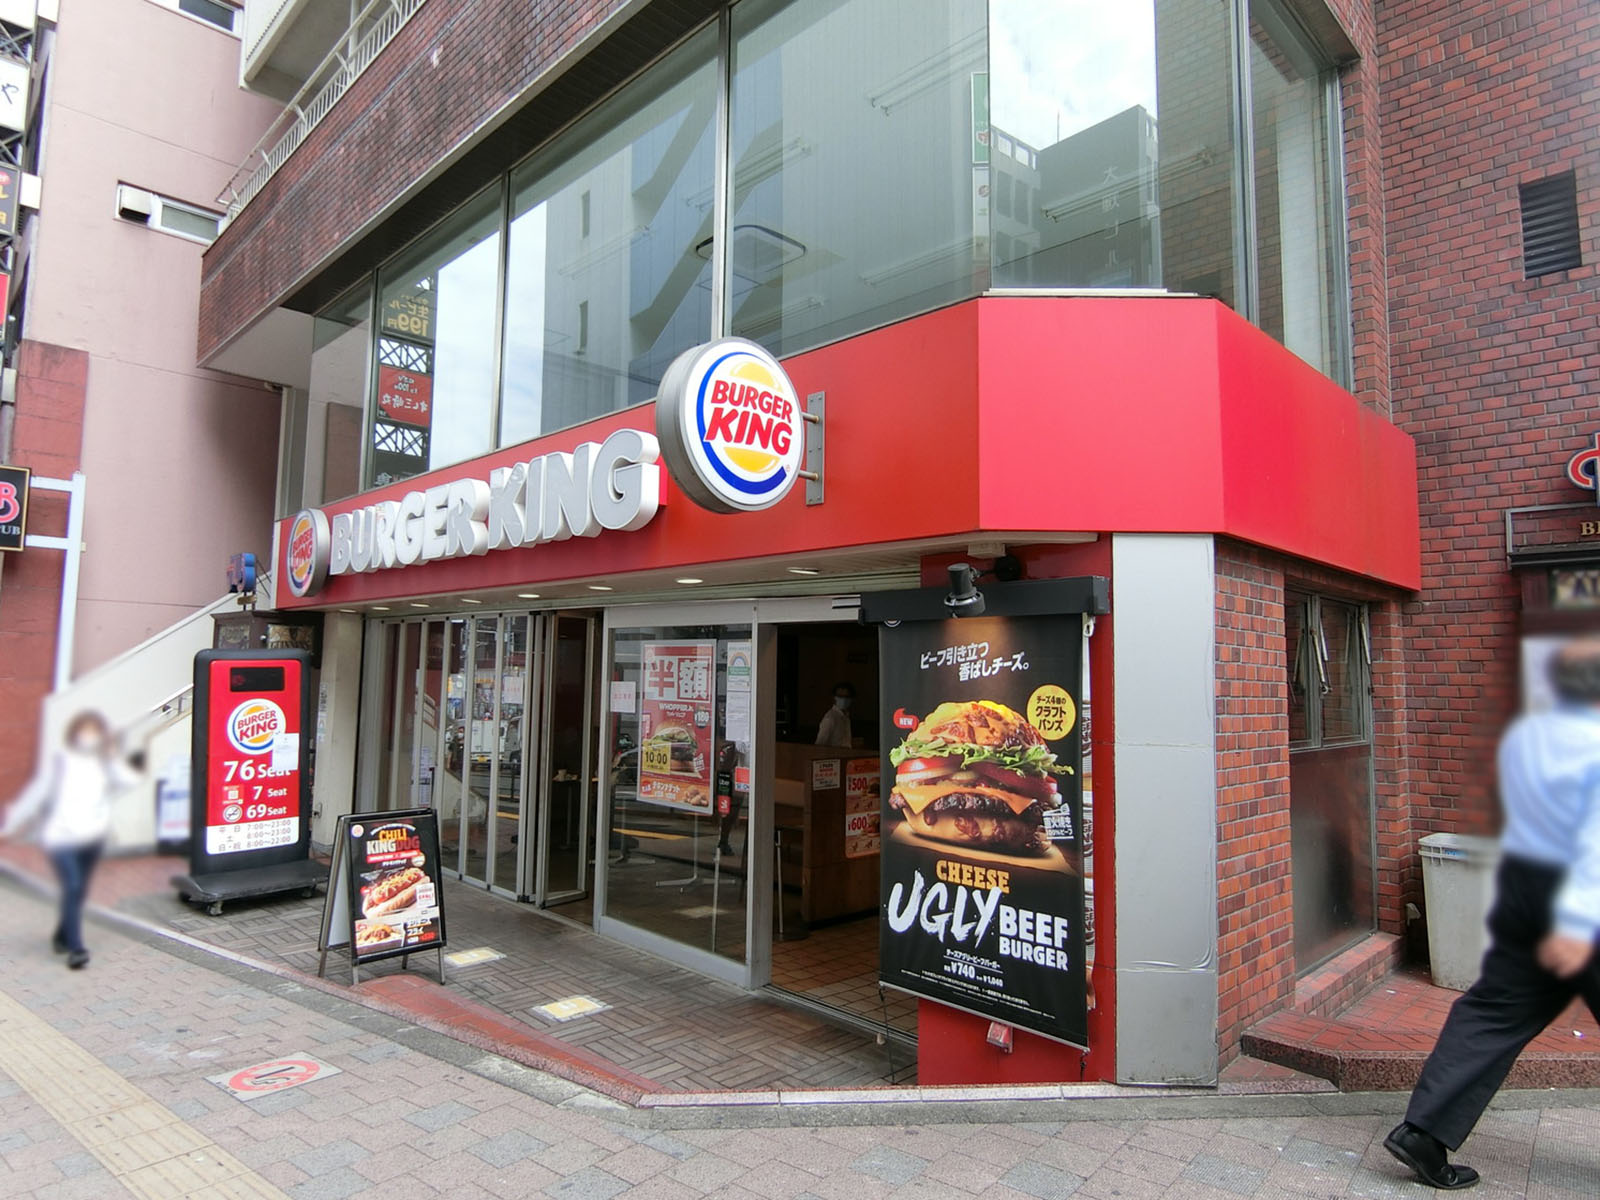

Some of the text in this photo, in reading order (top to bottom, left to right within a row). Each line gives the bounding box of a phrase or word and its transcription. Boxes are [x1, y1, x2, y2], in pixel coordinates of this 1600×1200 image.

[711, 380, 793, 423] BURGER
[705, 407, 793, 455] KING
[330, 428, 660, 576] BURGER KING
[293, 526, 314, 553] BURGER
[292, 540, 314, 572] KING
[920, 641, 989, 670] ビーフ引き立つ
[959, 651, 1029, 682] 香ばしチーズ。
[648, 659, 709, 699] 半額
[238, 710, 276, 729] BURGER
[899, 717, 913, 726] NEW
[1035, 706, 1067, 719] クラフト
[1038, 719, 1064, 732] バンズ
[240, 718, 278, 742] KING
[223, 759, 256, 783] 76
[253, 785, 264, 800] 7
[267, 788, 288, 797] Seat
[246, 804, 287, 819] 69 Seat
[366, 836, 420, 855] KING DOG
[379, 828, 407, 842] CHILI
[936, 860, 1010, 894] CHEESE
[888, 868, 1002, 949] UGLY
[1000, 904, 1068, 949] BEEF
[1000, 936, 1068, 971] BURGER
[951, 962, 975, 979] ¥740
